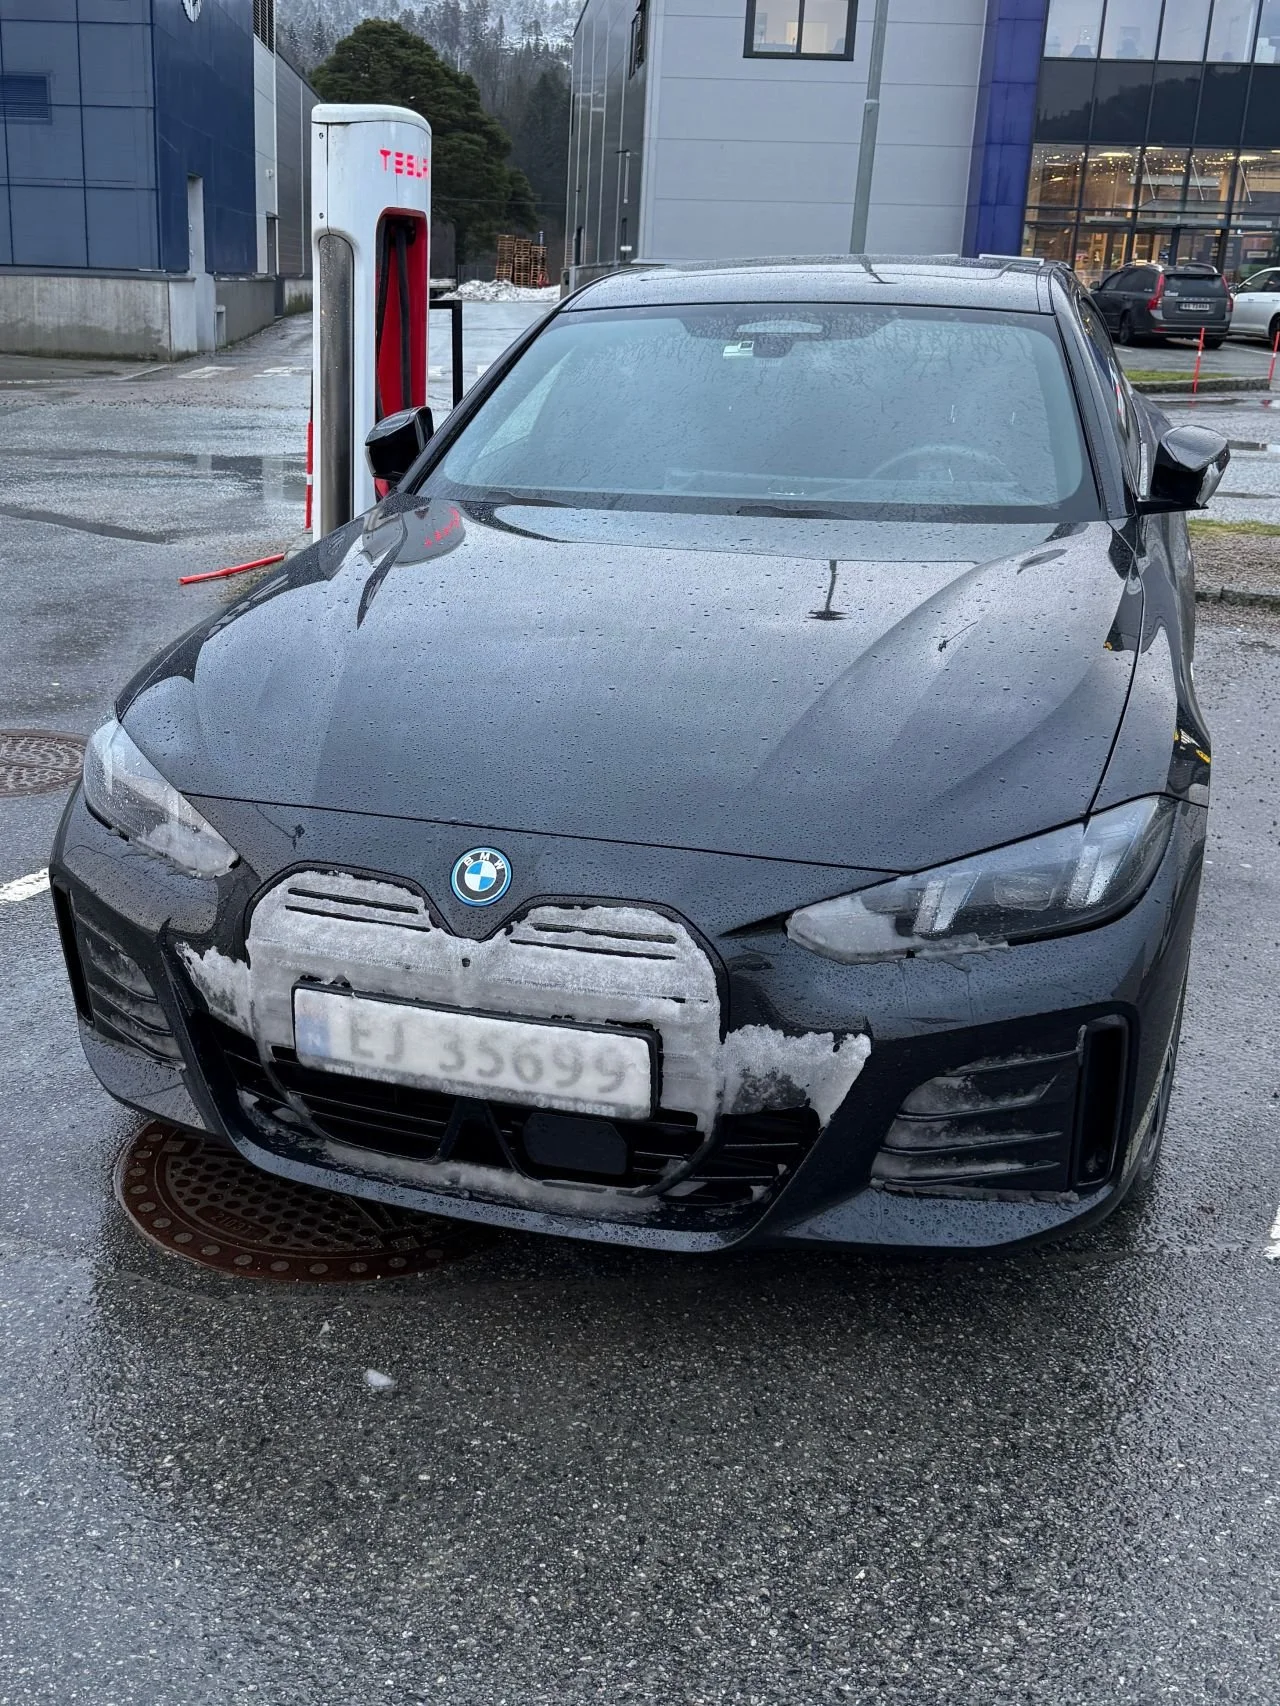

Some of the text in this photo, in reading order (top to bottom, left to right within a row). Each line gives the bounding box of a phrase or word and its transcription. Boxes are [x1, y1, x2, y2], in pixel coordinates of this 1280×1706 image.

[463, 852, 504, 870] BMW
[307, 1032, 321, 1047] N
[350, 1009, 626, 1094] EJ 35699
